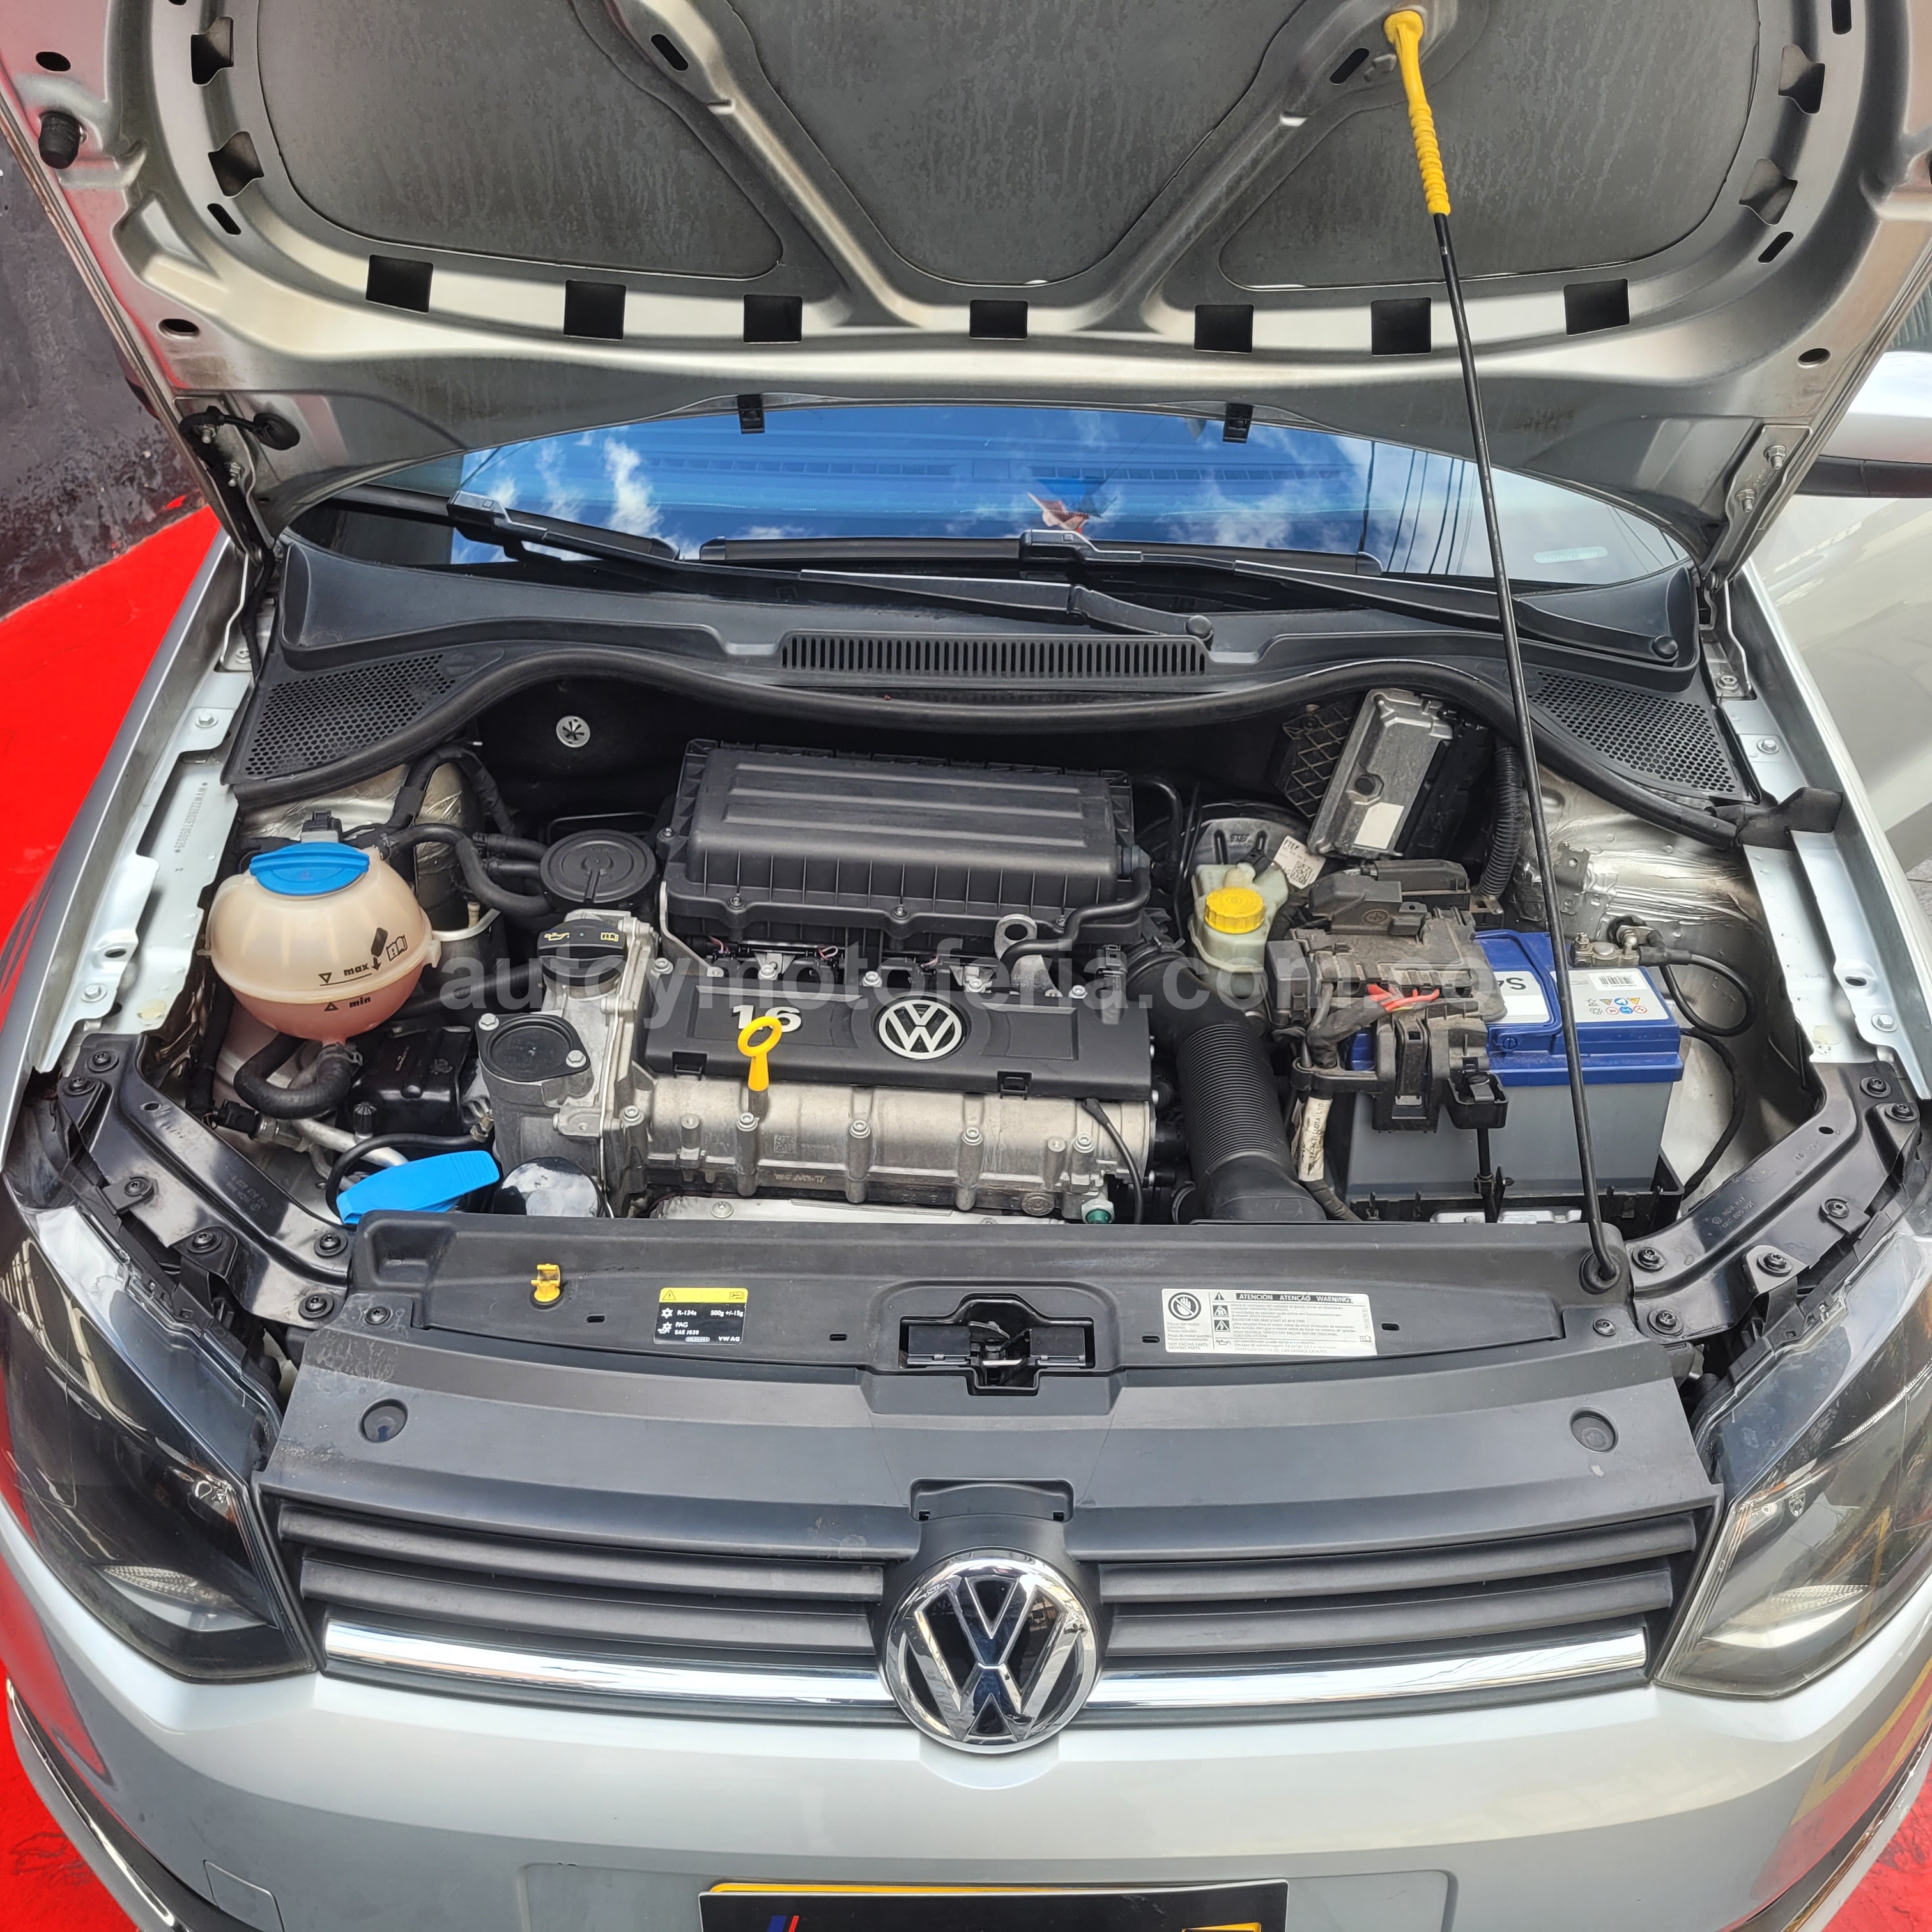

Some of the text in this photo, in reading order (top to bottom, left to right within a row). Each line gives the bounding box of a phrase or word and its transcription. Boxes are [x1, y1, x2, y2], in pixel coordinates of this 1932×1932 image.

[343, 963, 370, 976] max
[349, 997, 371, 1008] min
[878, 999, 962, 1059] VW
[1280, 1294, 1311, 1302] ATENÇÃO
[885, 1546, 1098, 1754] VW
